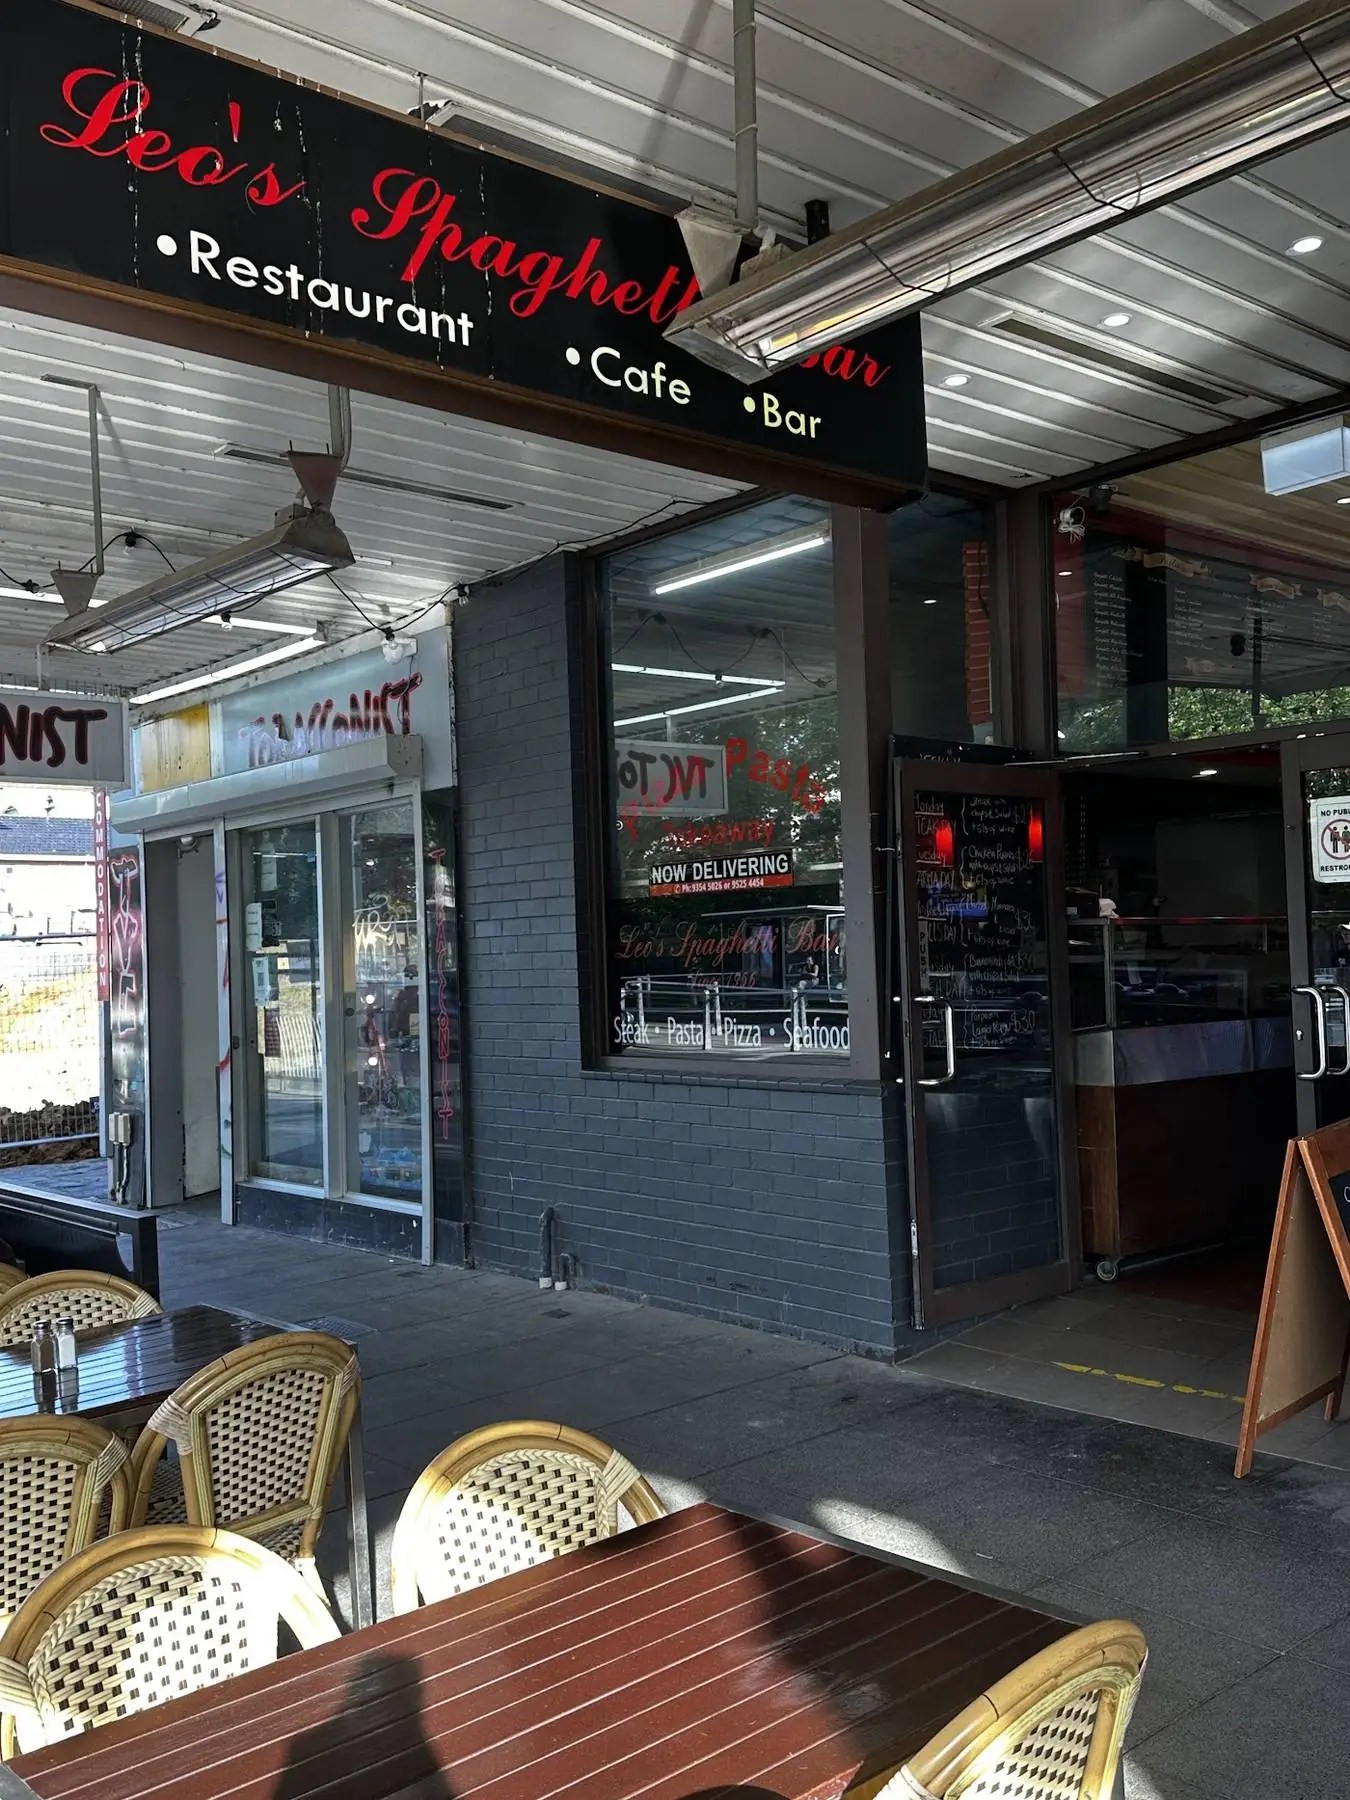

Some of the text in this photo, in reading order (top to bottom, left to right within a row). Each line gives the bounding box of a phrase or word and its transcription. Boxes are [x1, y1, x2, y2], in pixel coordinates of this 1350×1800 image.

[39, 67, 305, 208] Leo's
[351, 167, 704, 323] Spaghett
[189, 229, 475, 348] Restaurant
[590, 346, 692, 405] Cafe
[763, 392, 822, 439] Bar
[651, 853, 789, 885] NOW DELIVERING
[723, 882, 731, 890] or
[1320, 864, 1350, 872] RESTRO
[670, 919, 780, 968] Spaghetti
[613, 1016, 850, 1050] Steak Pasta Pizza Seafood
